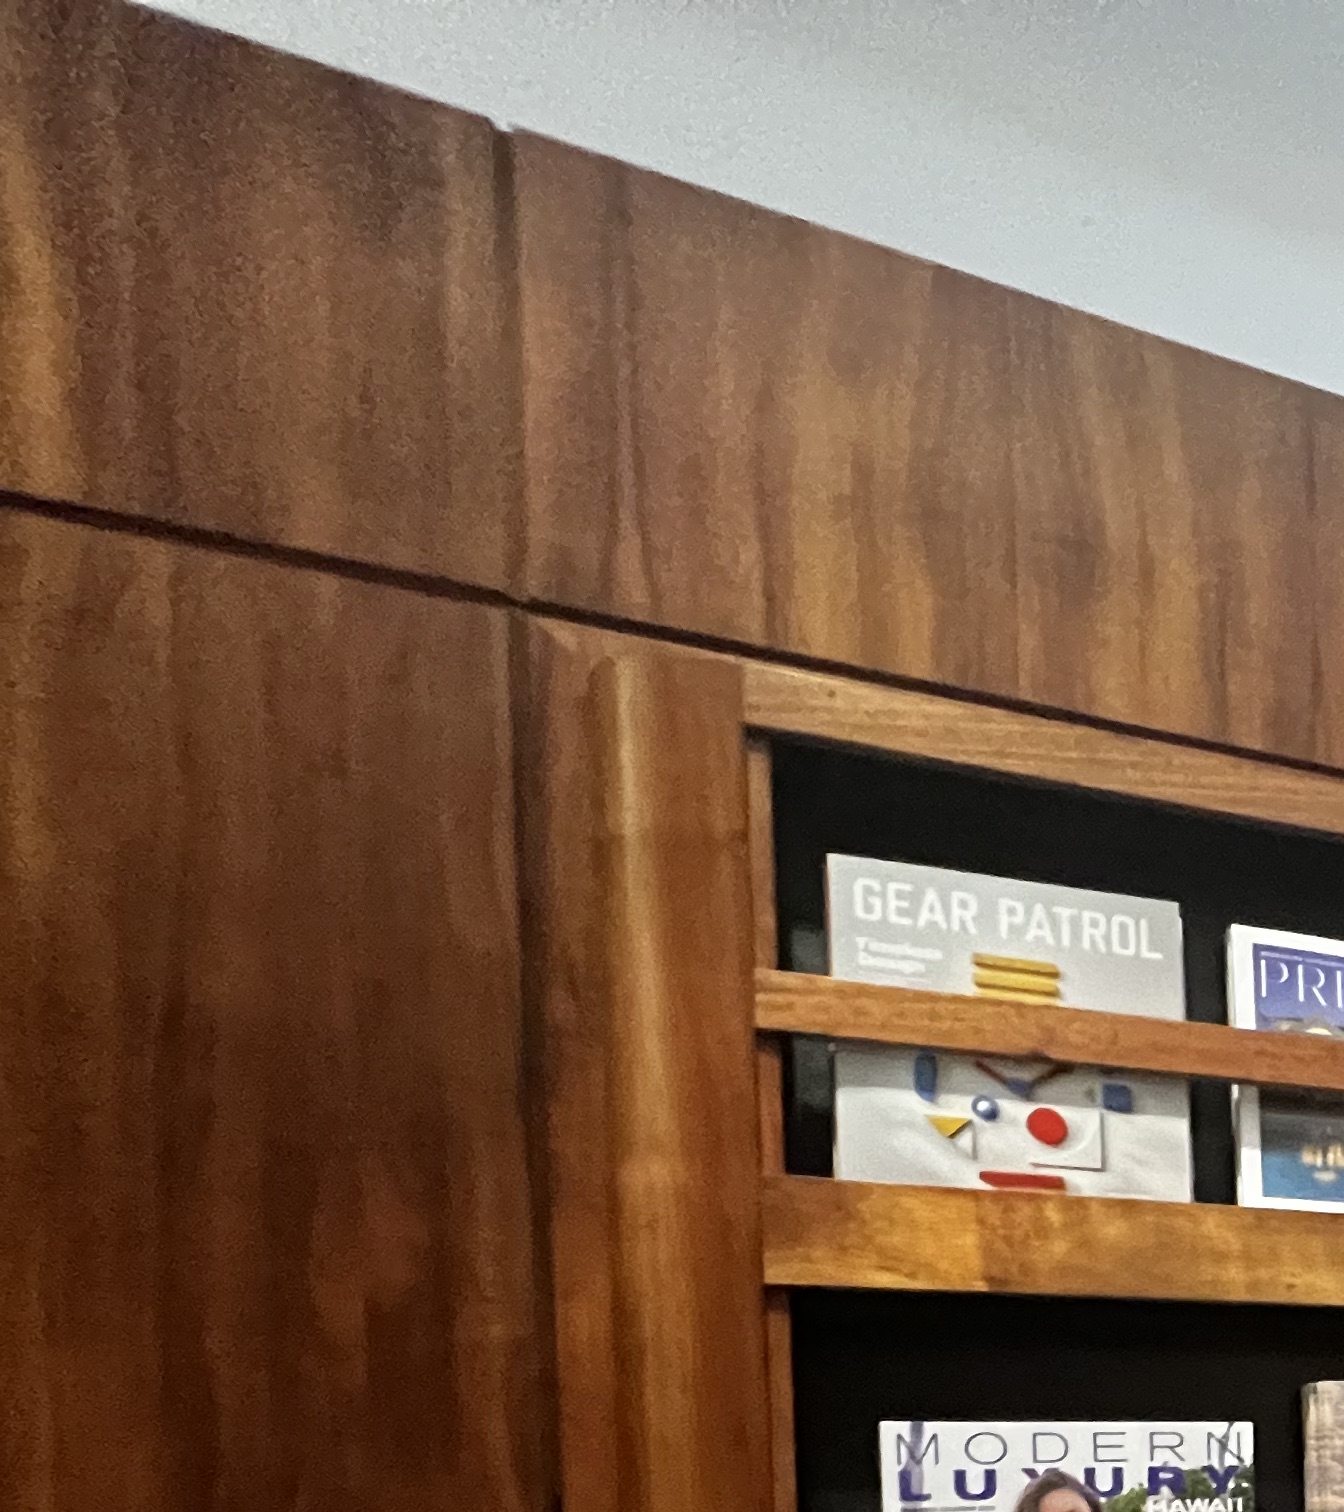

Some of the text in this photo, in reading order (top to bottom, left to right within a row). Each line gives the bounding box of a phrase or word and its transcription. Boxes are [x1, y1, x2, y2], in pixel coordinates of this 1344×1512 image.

[853, 877, 978, 935] GEAR
[998, 897, 1164, 959] PATROL
[896, 1430, 1243, 1466] MODERN
